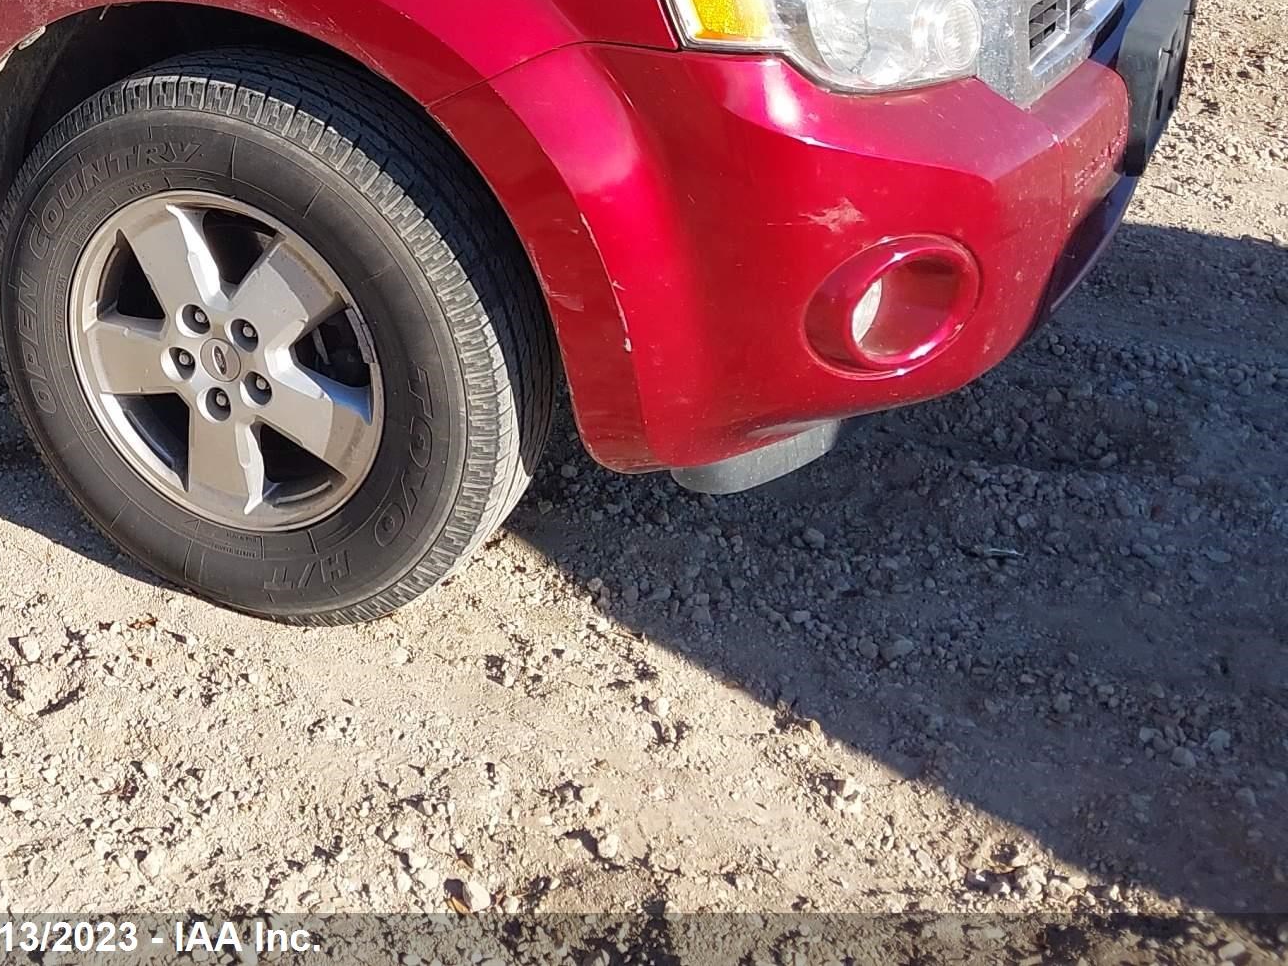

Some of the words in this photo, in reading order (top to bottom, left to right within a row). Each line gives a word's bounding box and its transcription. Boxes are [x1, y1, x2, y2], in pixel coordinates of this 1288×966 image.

[29, 142, 202, 260] COUNTRY
[17, 271, 58, 414] OPEN
[372, 367, 435, 548] TOYO
[263, 549, 353, 591] H/T
